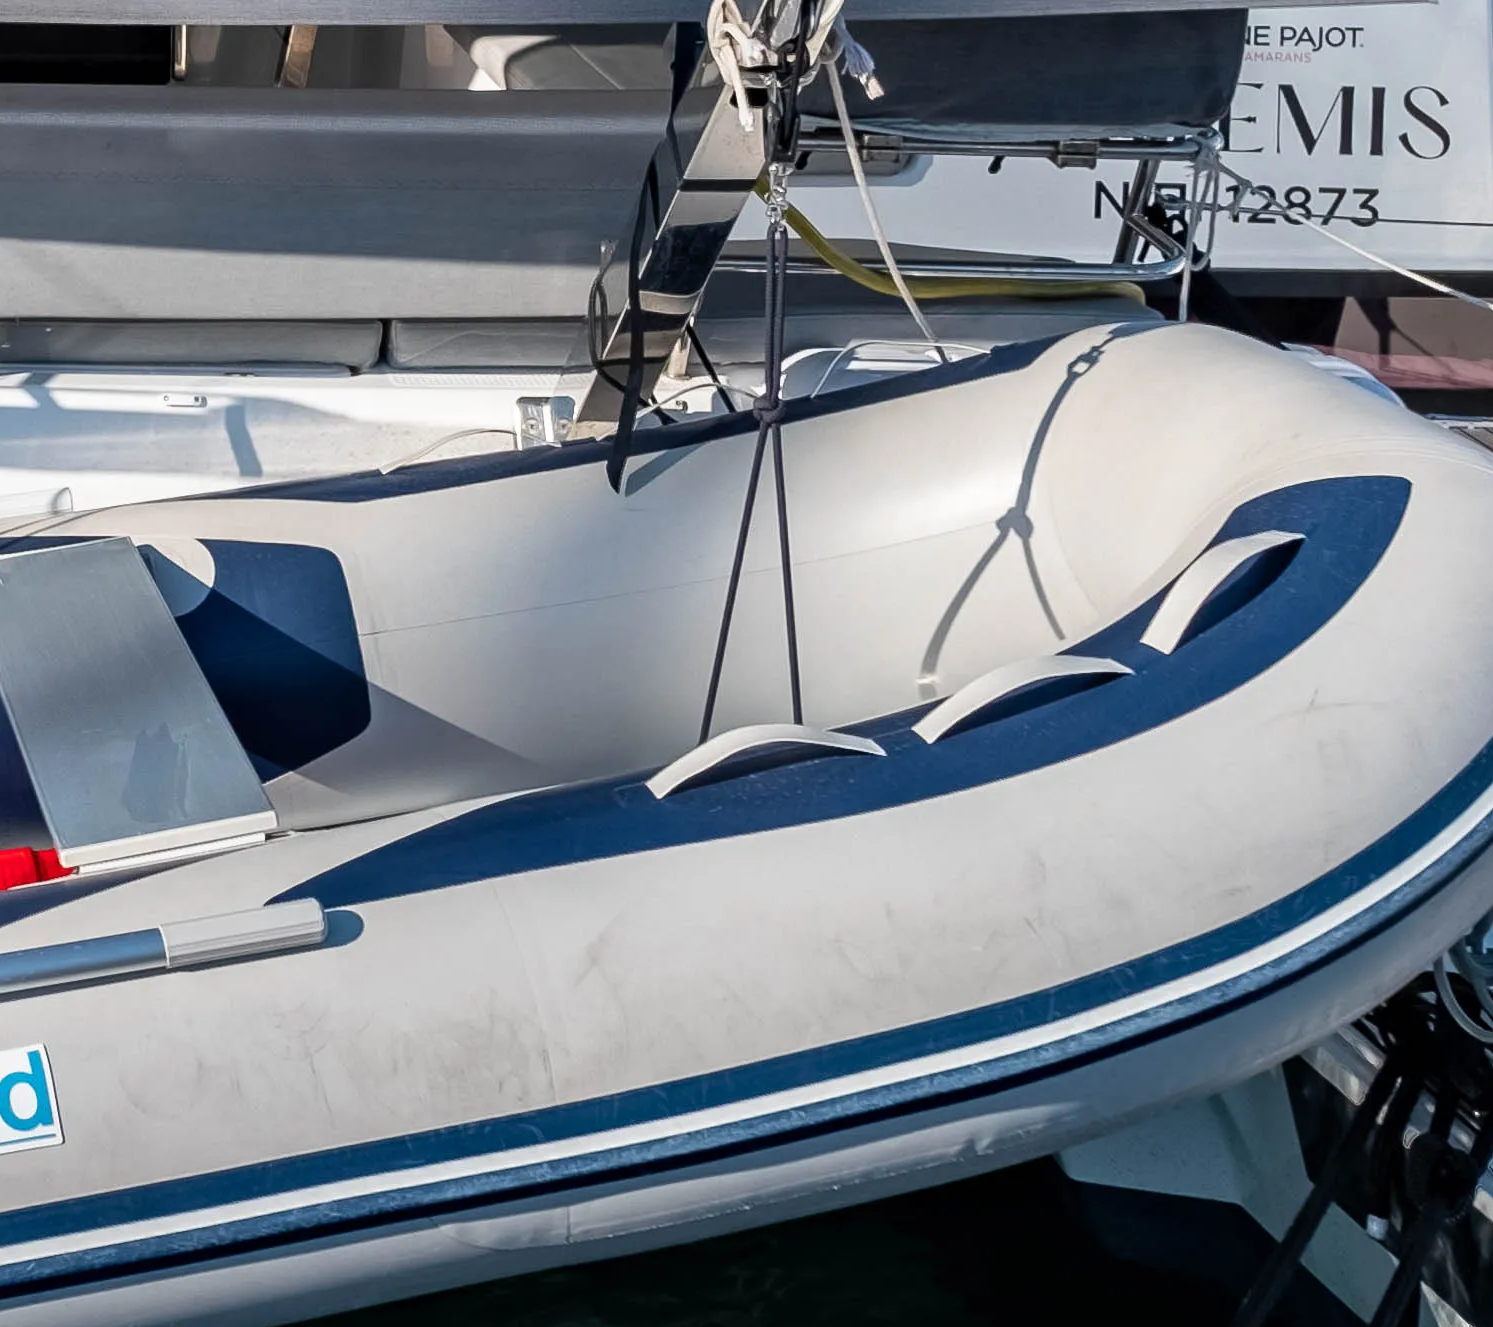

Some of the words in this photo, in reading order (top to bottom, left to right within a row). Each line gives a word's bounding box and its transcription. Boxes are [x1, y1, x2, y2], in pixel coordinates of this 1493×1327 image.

[1280, 26, 1365, 52] PAJOT
[1244, 51, 1312, 63] AMARANS
[1218, 82, 1451, 160] EMIS
[1225, 183, 1380, 227] 12873
